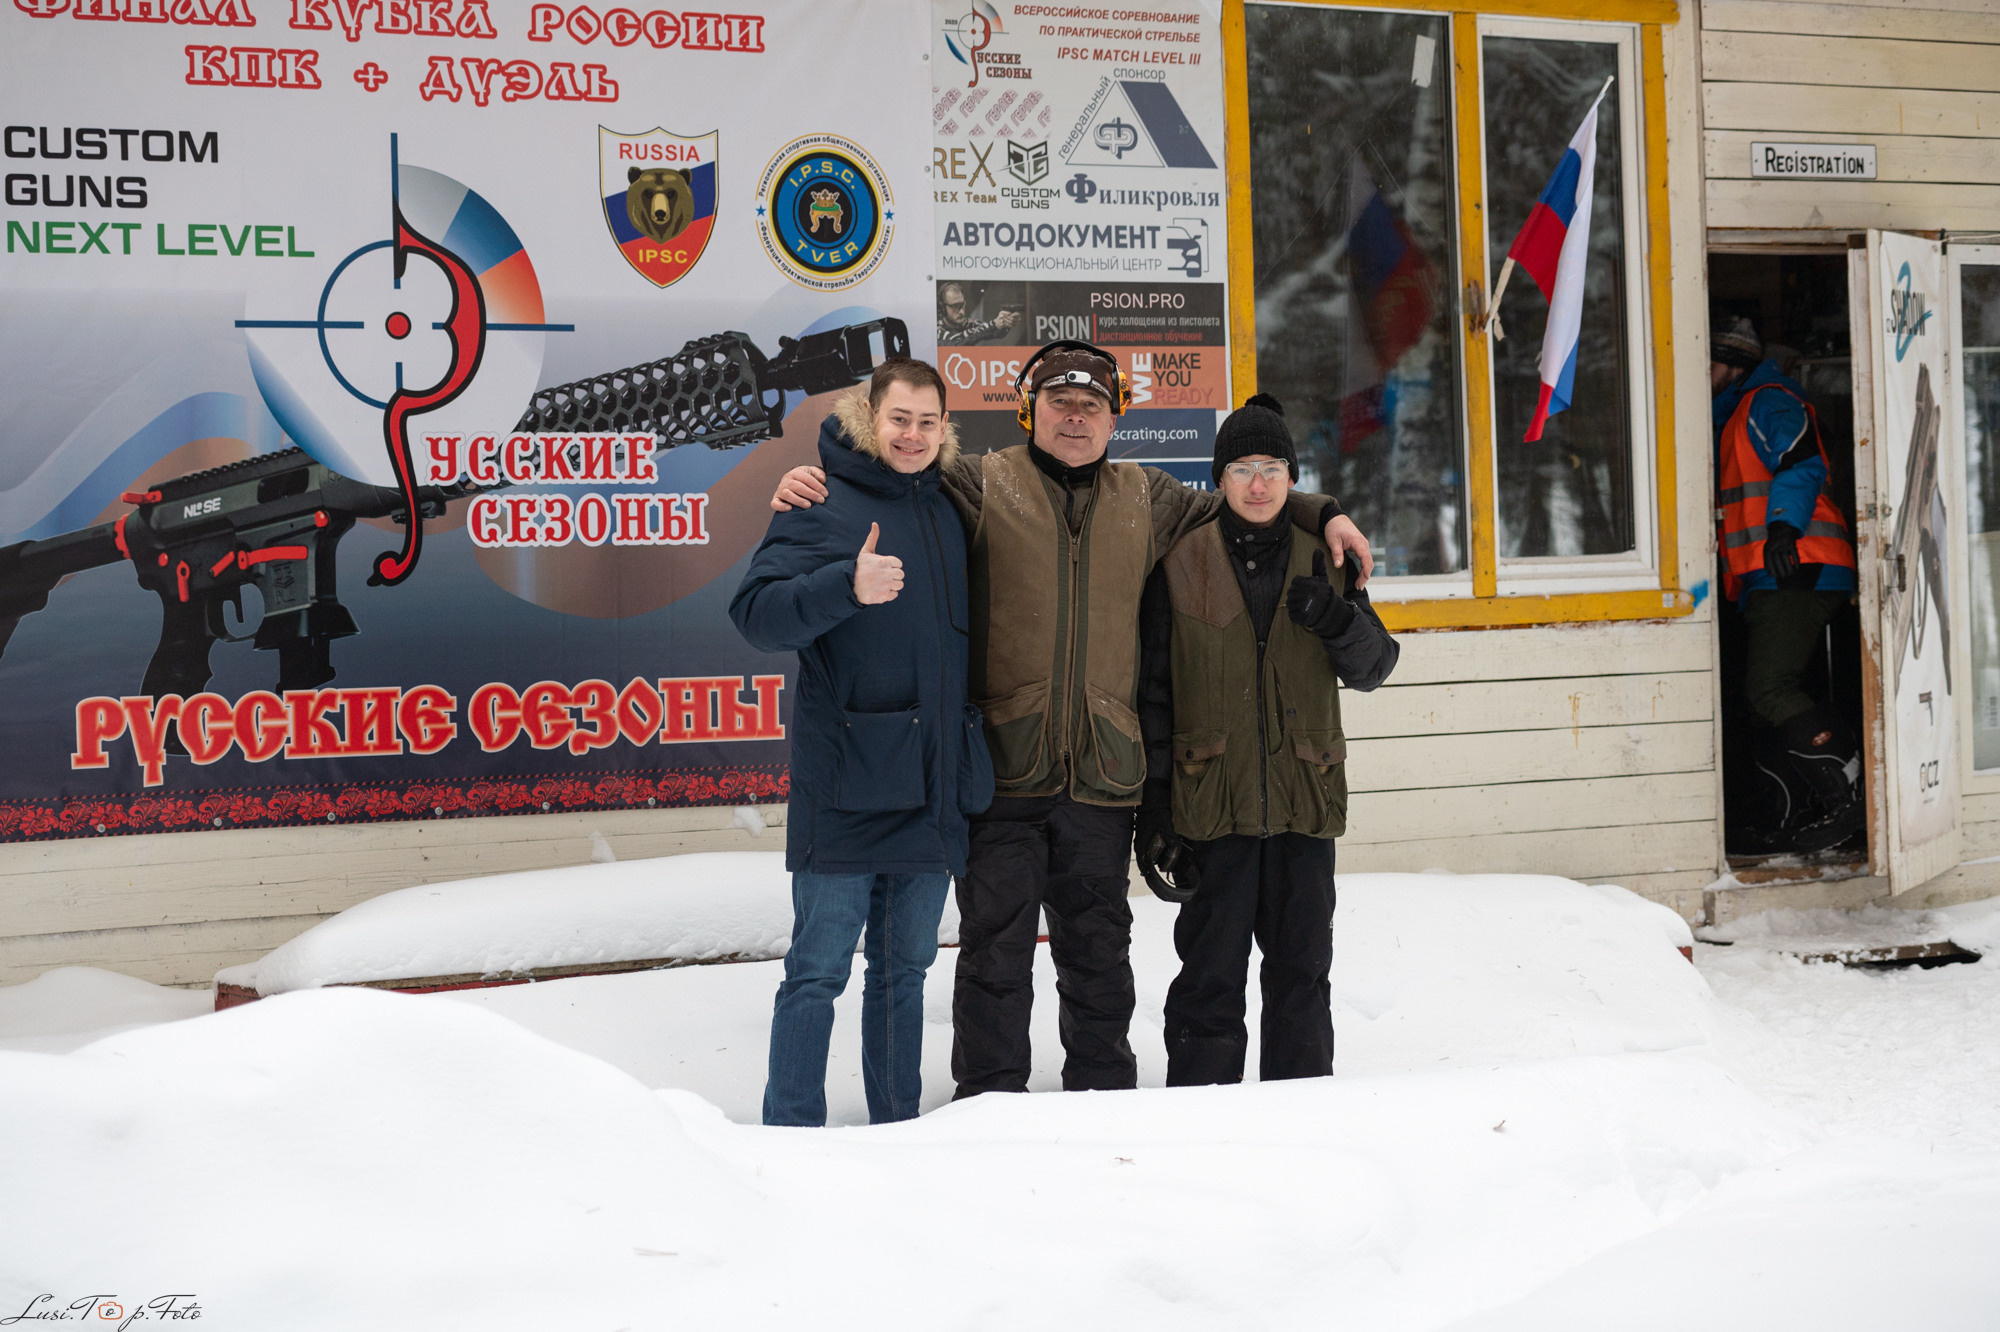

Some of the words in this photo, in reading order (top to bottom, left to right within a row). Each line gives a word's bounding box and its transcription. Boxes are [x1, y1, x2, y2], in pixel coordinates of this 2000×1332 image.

[1014, 5, 1109, 19] ВСЕРОССИЙСКОЕ
[1112, 11, 1200, 24] СОРЕВНОВАНИЕ
[289, 0, 498, 42] КУБКА
[528, 3, 765, 53] РОССИИ
[1039, 25, 1054, 36] ПО
[1057, 26, 1142, 40] ПРАКТИЧЕСКОЙ
[1145, 31, 1200, 43] СТРЕЛЬБЕ
[1057, 47, 1089, 60] IPSC
[1093, 49, 1139, 63] MATCH
[1143, 51, 1185, 65] LEVEL
[185, 44, 321, 90] КПК
[420, 56, 619, 107] ДУЭЛЬ
[986, 66, 1032, 79] СЕЗОНЫ
[933, 87, 962, 124] ЕРЛЕН
[1058, 75, 1111, 159] генеральный
[1114, 68, 1166, 83] спонсор
[4, 125, 219, 163] CUSTOM
[618, 142, 701, 163] RUSSIA
[789, 161, 855, 189] I.P.S.C.
[4, 173, 149, 209] GUNS
[1001, 188, 1060, 198] CUSTOM
[1065, 173, 1220, 212] Филикровля
[1011, 199, 1049, 209] GUNS
[6, 220, 142, 256] NEXT
[157, 223, 315, 258] LEVEL
[943, 222, 1160, 251] АВТОДОКУМЕНТ
[638, 249, 688, 265] IPSC
[796, 239, 859, 264] TVER
[942, 255, 1119, 271] МНОГОФУНКЦИОНАЛЬНЫЙ
[1122, 257, 1162, 273] ЦЕНТР
[1090, 293, 1185, 309] PSION.PRO
[1035, 315, 1090, 340] PSION
[1099, 317, 1117, 327] курс
[1120, 316, 1165, 327] холощения
[1168, 317, 1177, 326] из
[1179, 317, 1220, 327] пистолета
[1099, 331, 1162, 342] дистанционное
[1164, 330, 1202, 342] обучение
[1153, 353, 1201, 369] MAKE
[1132, 352, 1152, 405] WE
[1154, 370, 1191, 387] YOU
[1154, 388, 1214, 405] READY
[467, 493, 709, 548] СЕЗОНЫ
[71, 684, 457, 787] РУССКИЕ
[468, 674, 785, 756] СЕЗОНЫ
